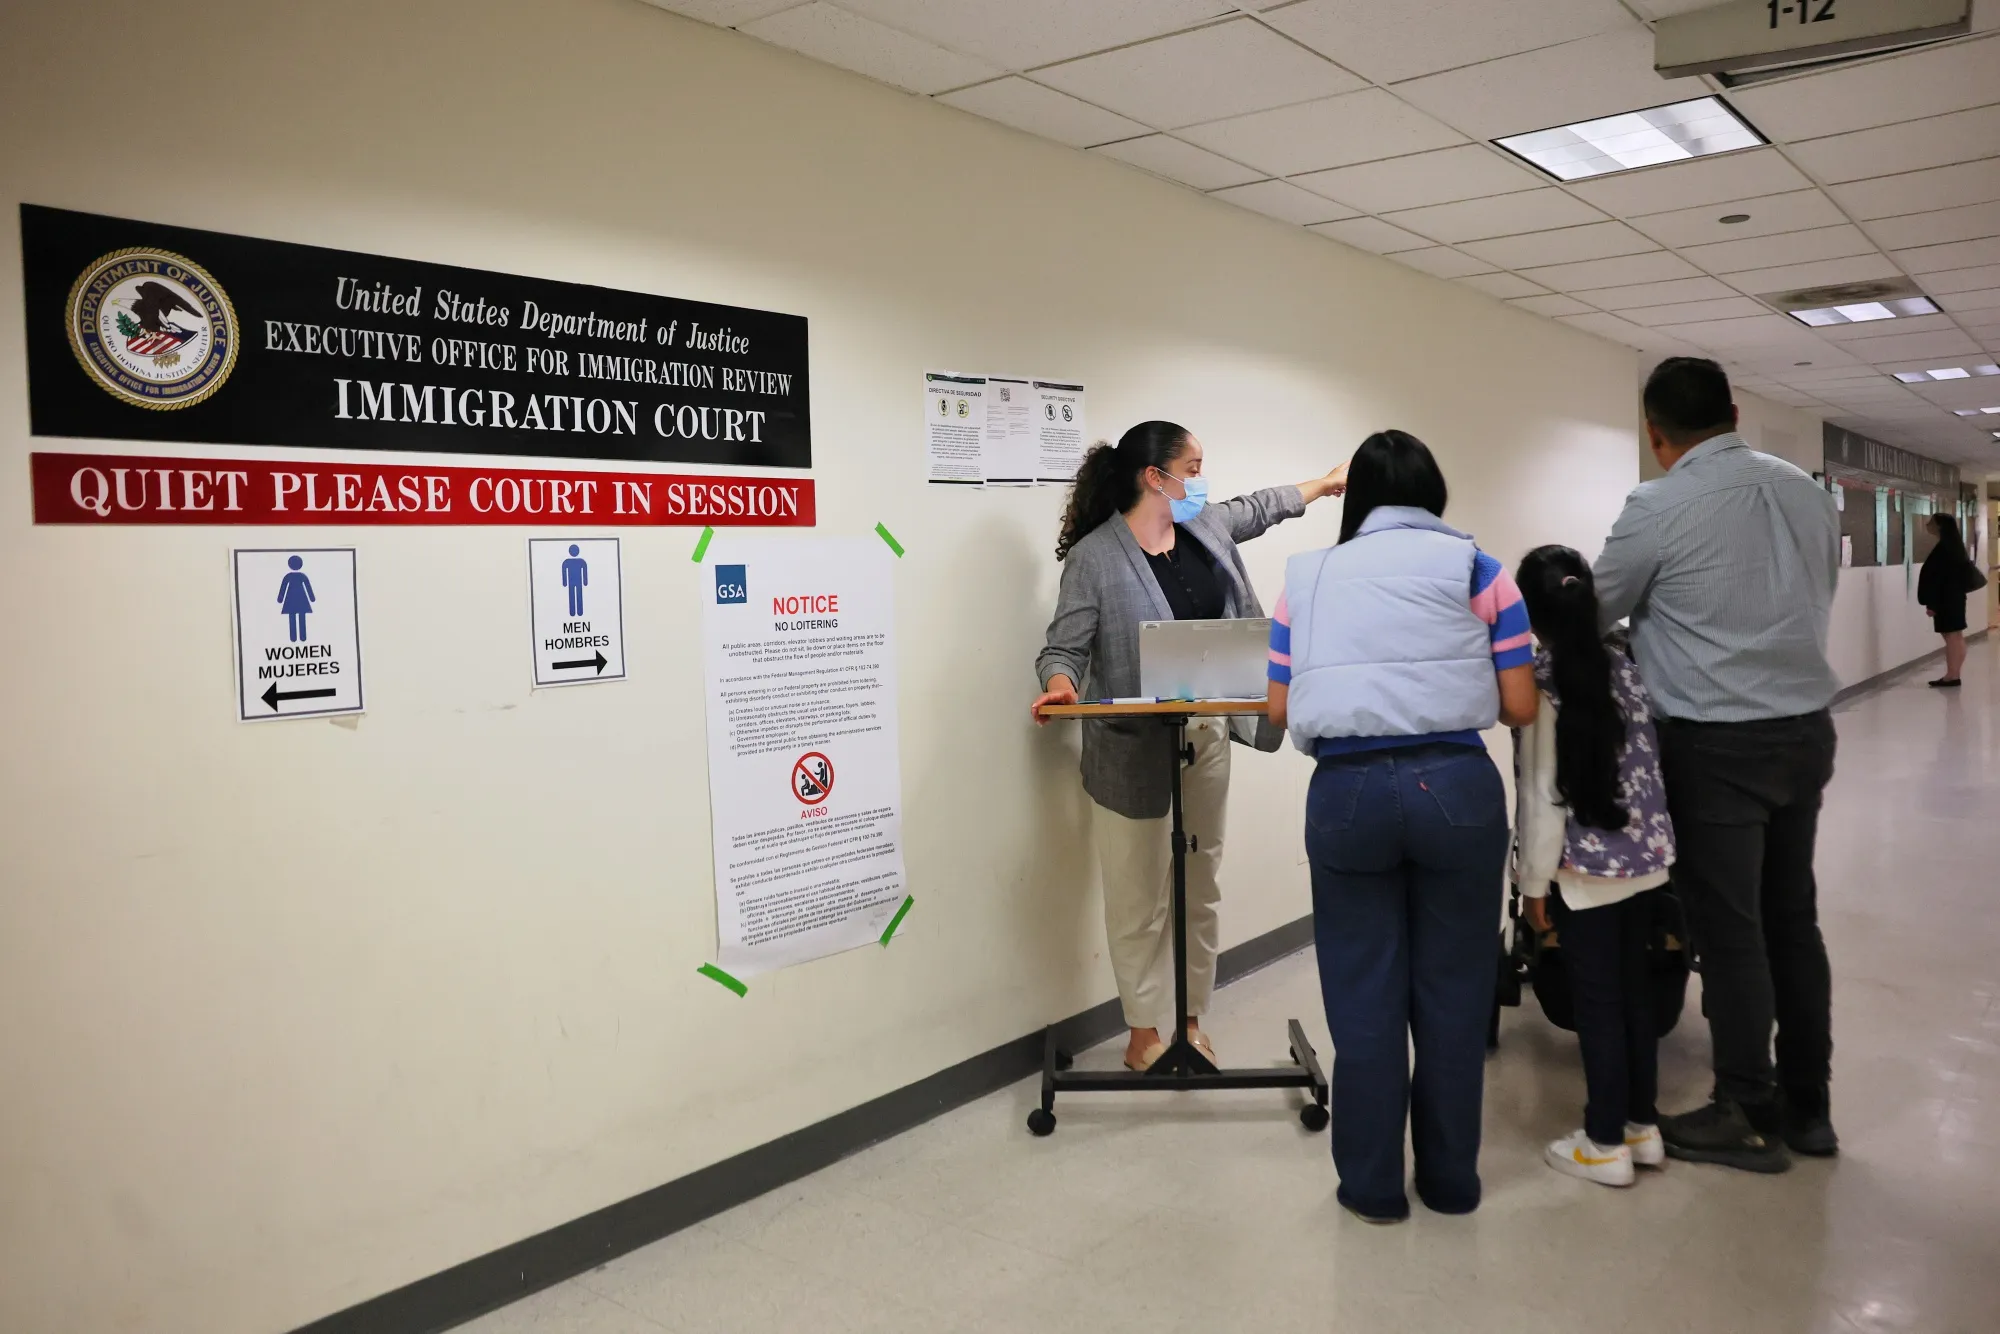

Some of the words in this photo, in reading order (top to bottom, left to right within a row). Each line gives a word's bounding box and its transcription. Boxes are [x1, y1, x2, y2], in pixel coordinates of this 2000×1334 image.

[1767, 0, 1836, 29] 1-12
[82, 261, 162, 334] DEPARTMENT
[166, 266, 191, 282] OF
[190, 281, 226, 348] JUSTICE
[336, 276, 422, 317] United
[434, 289, 510, 327] States
[519, 300, 648, 343] Department
[657, 319, 678, 346] of
[686, 322, 750, 355] Justice
[89, 341, 119, 377] EXECUTIVE
[118, 372, 143, 392] OFFICE
[145, 386, 160, 395] FOR
[105, 335, 118, 354] PRO
[116, 353, 152, 378] DOMINA
[264, 319, 422, 363] EXECUTIVE
[431, 337, 517, 372] OFFICE
[526, 347, 570, 376] FOR
[578, 352, 715, 389] IMMIGRATION
[721, 367, 793, 397] REVIEW
[333, 378, 639, 436] IMMIGRATION
[654, 403, 766, 443] COURT
[70, 467, 248, 517] QUIET
[270, 472, 451, 512] PLEASE
[469, 477, 597, 514] COURT
[612, 481, 653, 515] IN
[667, 483, 799, 517] SESSION
[717, 584, 745, 599] GSA
[773, 595, 839, 616] NOTICE
[563, 621, 591, 634] MEN
[775, 621, 788, 632] NO
[790, 618, 839, 631] LOITERING
[265, 644, 332, 661] WOMEN
[545, 635, 610, 651] HOMBRES
[258, 661, 340, 680] MUJERES
[800, 806, 828, 820] AVISO
